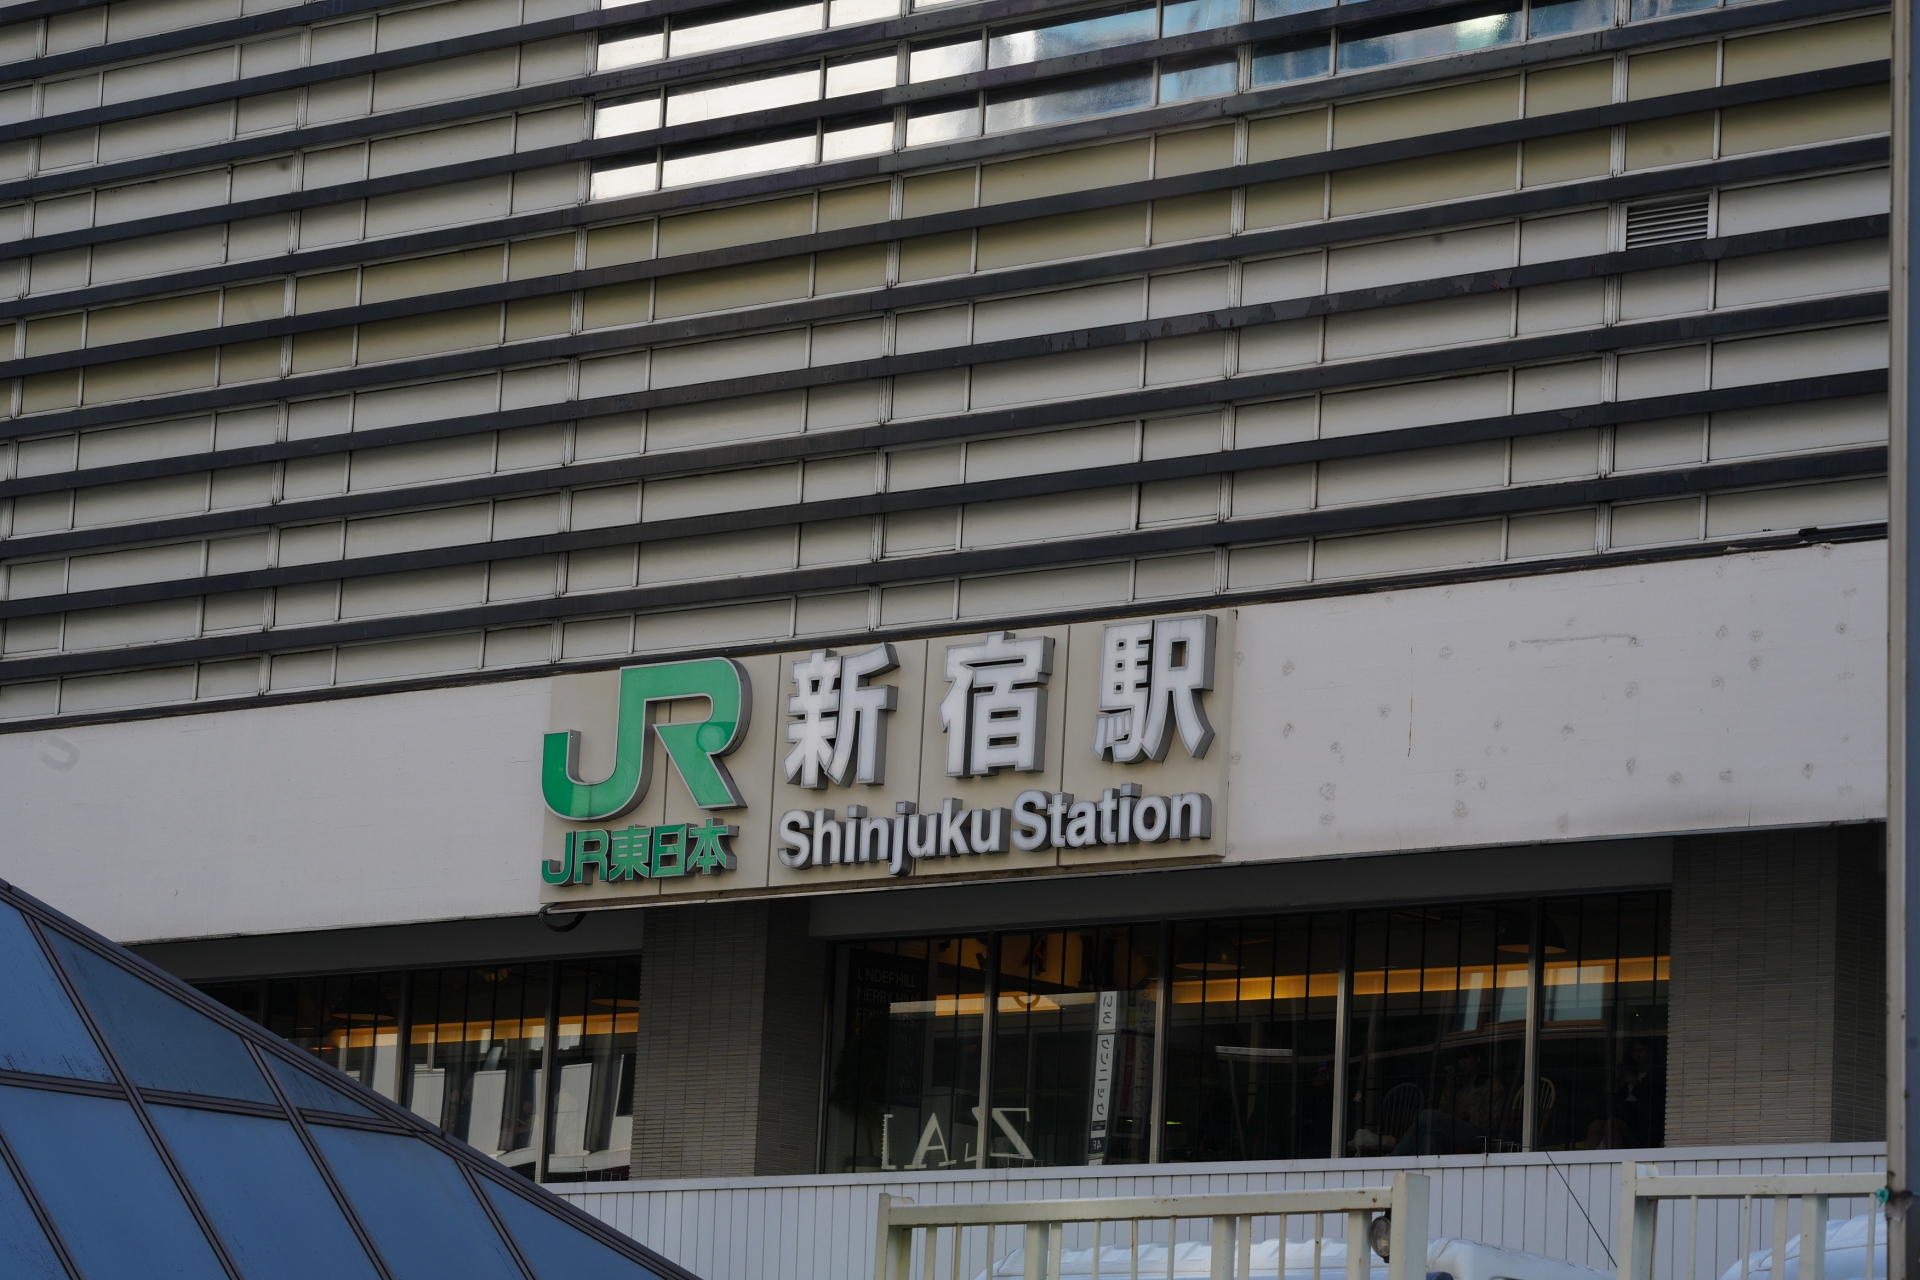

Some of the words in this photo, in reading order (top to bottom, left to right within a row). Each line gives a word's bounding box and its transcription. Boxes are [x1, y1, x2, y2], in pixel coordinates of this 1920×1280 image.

[541, 657, 750, 822] JR
[783, 614, 1216, 790] 新宿駅
[541, 817, 738, 887] JR東日本
[777, 796, 1011, 876] Shinjuku
[1011, 782, 1212, 853] Station
